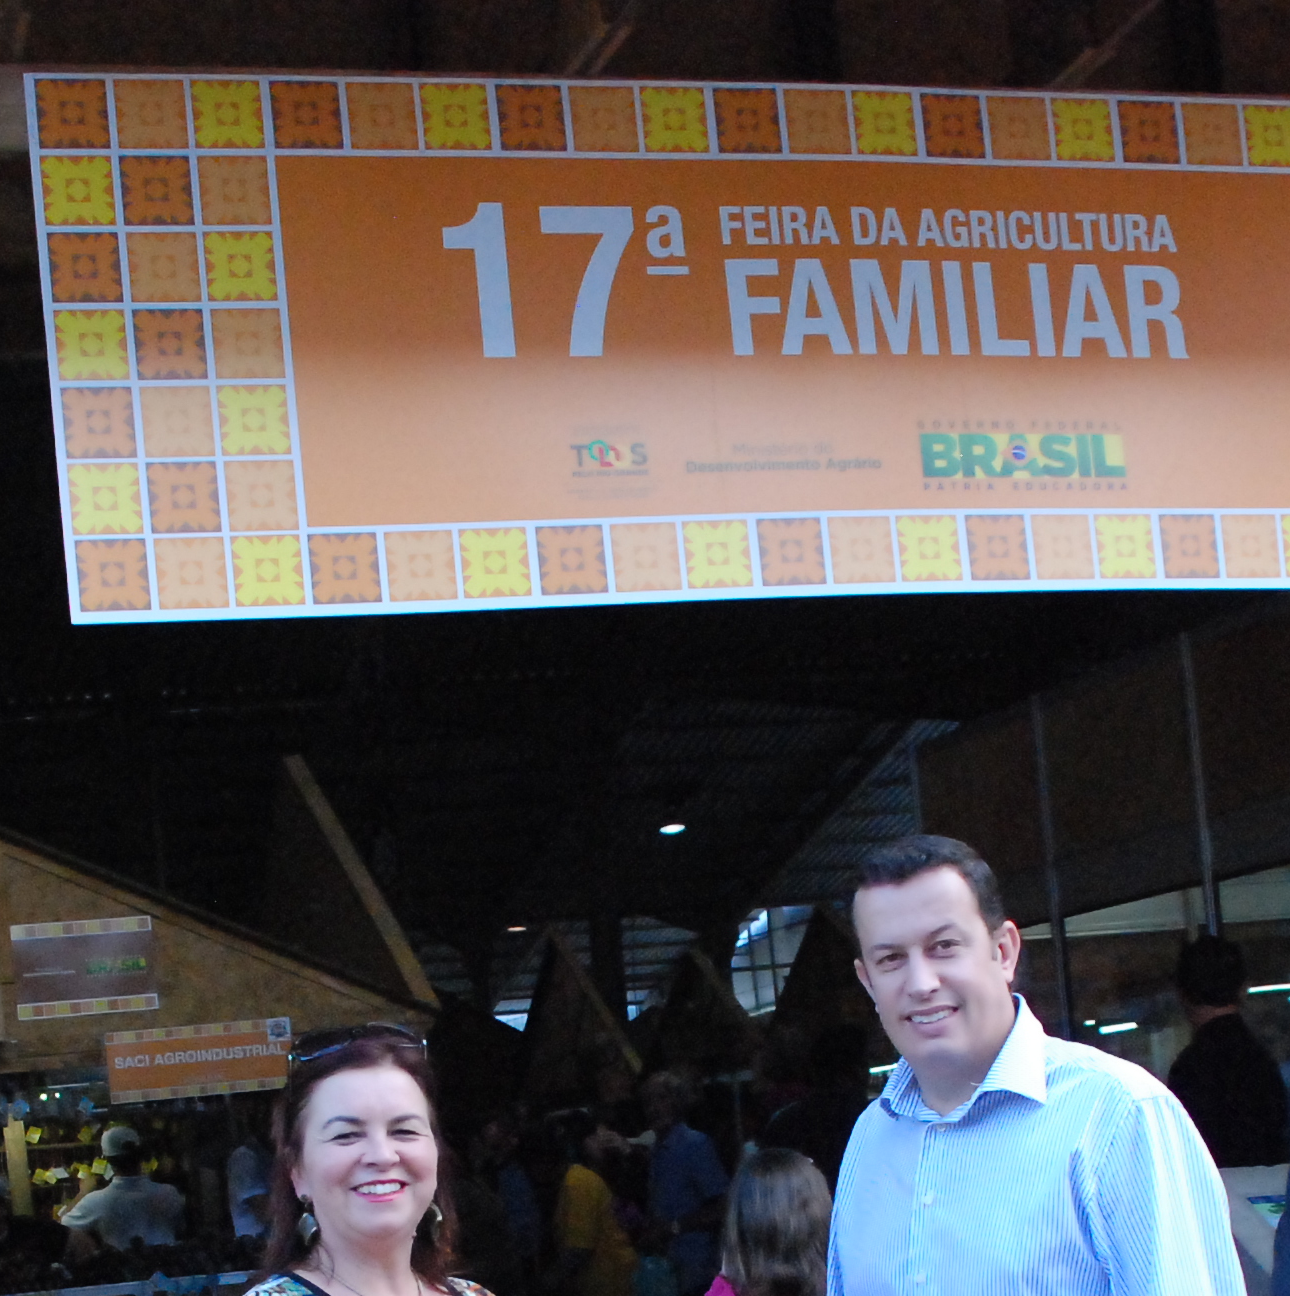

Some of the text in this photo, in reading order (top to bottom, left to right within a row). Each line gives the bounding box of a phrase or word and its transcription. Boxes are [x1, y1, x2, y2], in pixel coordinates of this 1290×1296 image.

[718, 205, 1178, 253] FEIRA DA AGRICULTURA
[441, 201, 690, 358] 17ª
[723, 257, 1190, 360] FAMILIAR
[917, 420, 1121, 431] GOVERNO FEDERAL
[686, 456, 882, 474] Desenvolvimento Agrário
[919, 433, 1127, 479] BRASIL
[1012, 482, 1128, 491] EDUCADORA
[114, 1041, 288, 1070] SACI AGROINDUSTRIAL
